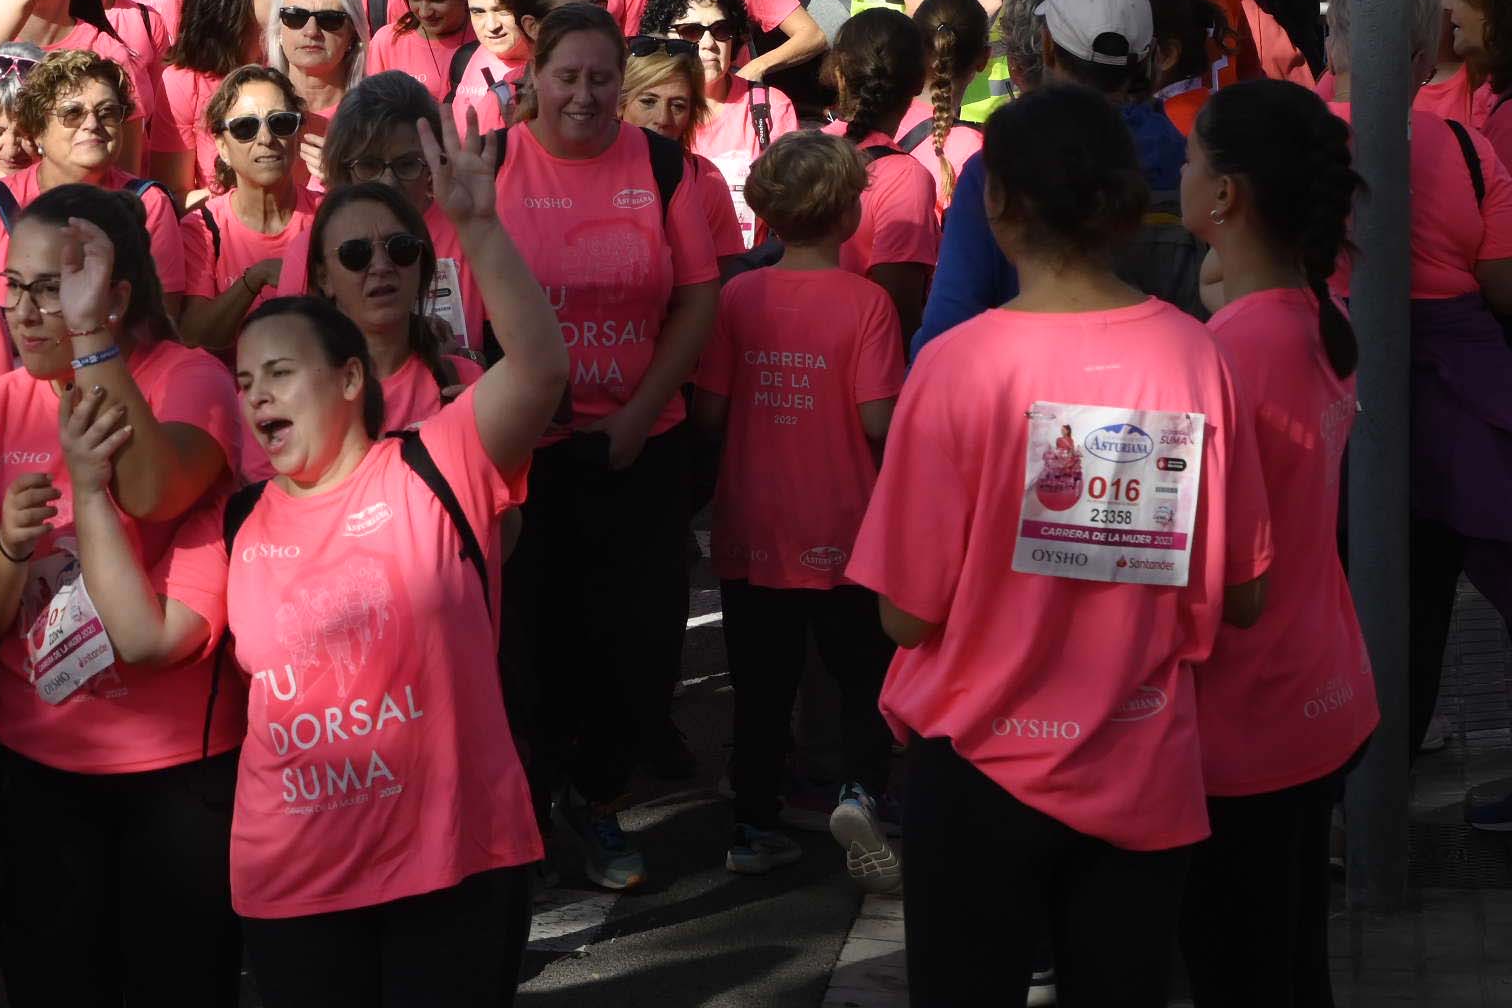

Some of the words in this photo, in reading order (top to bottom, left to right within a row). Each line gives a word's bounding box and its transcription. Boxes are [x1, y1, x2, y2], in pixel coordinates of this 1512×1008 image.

[523, 197, 573, 209] OYSHO
[545, 286, 567, 311] U
[560, 320, 648, 347] ORSAL
[745, 351, 827, 369] CARRERA
[574, 358, 624, 385] MA
[760, 371, 784, 387] DE
[791, 373, 810, 389] LA
[754, 392, 815, 411] MUJER
[1090, 435, 1149, 455] ASTURIANA
[1088, 476, 1141, 502] 016
[1090, 508, 1132, 525] 23358
[1040, 526, 1090, 540] CARRERA
[1091, 531, 1107, 541] DE
[1108, 532, 1121, 542] LA
[1122, 533, 1153, 544] MUJER
[1031, 548, 1088, 566] OYSHO
[1128, 557, 1175, 571] Santander
[252, 663, 298, 705] TU
[268, 684, 425, 756] DORSAL
[992, 717, 1081, 741] OYSHO
[281, 749, 396, 803] SUMA
